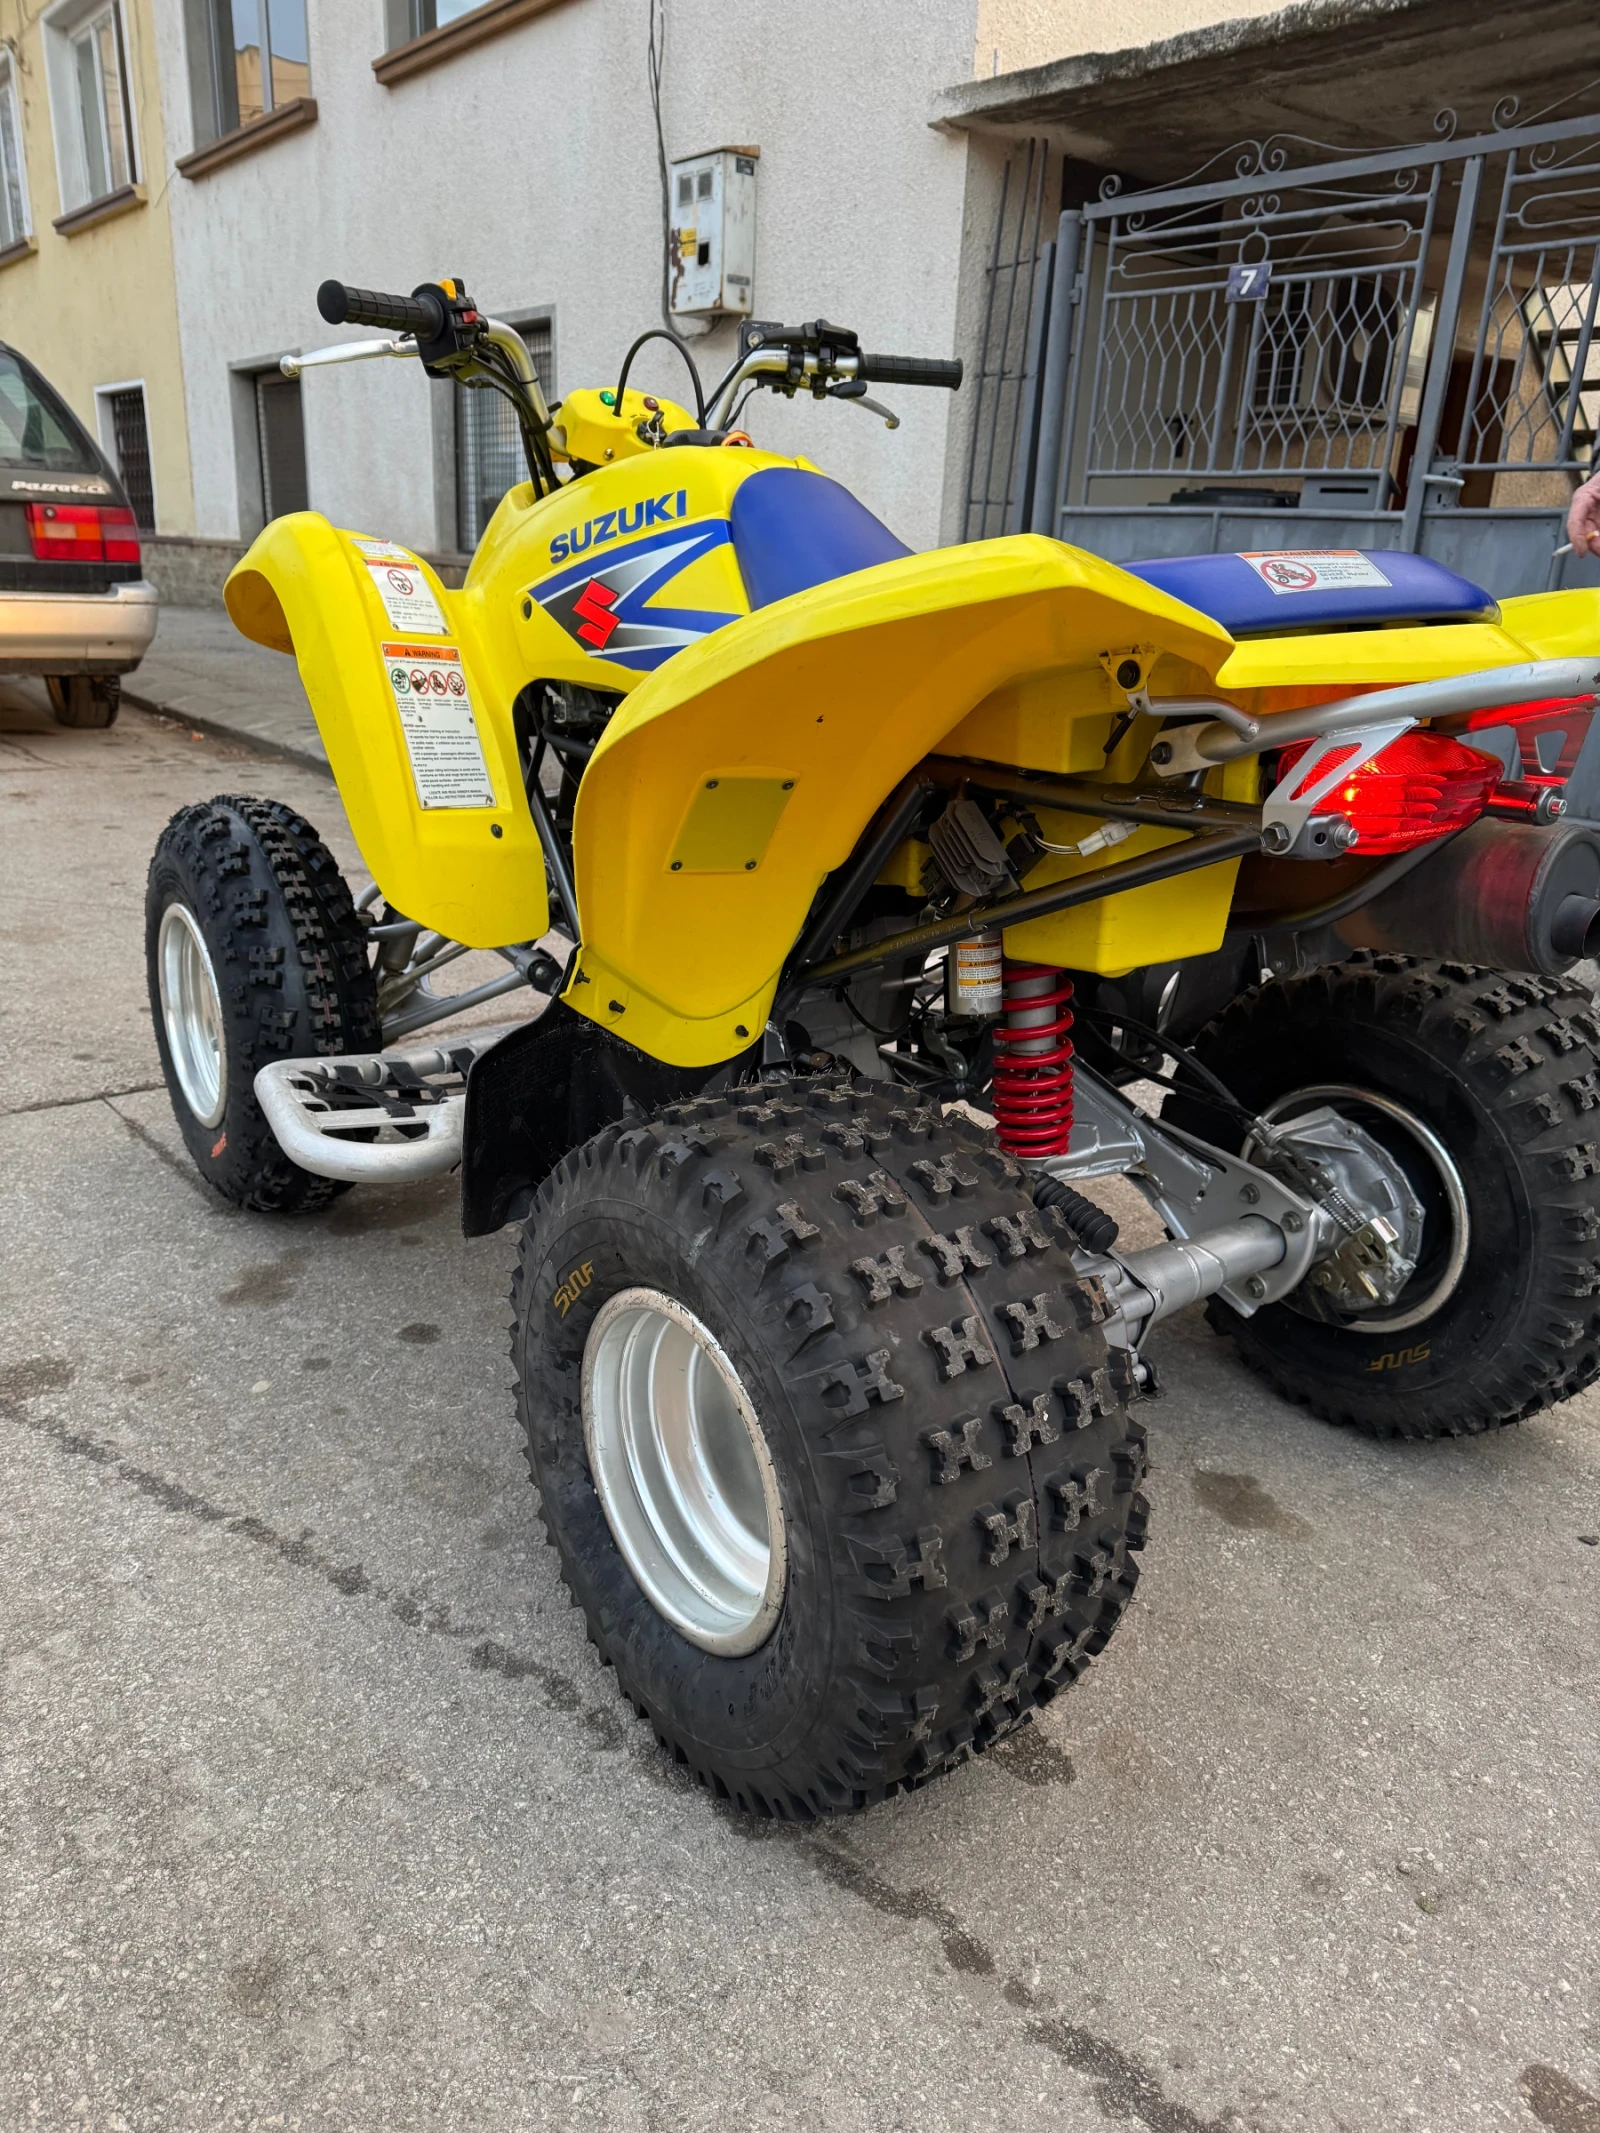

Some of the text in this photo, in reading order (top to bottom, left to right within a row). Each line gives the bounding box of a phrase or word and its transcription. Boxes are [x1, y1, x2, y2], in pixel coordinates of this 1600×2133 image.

[1239, 269, 1258, 296] 7
[549, 489, 687, 565] SUZUKI
[412, 651, 440, 659] WARNING
